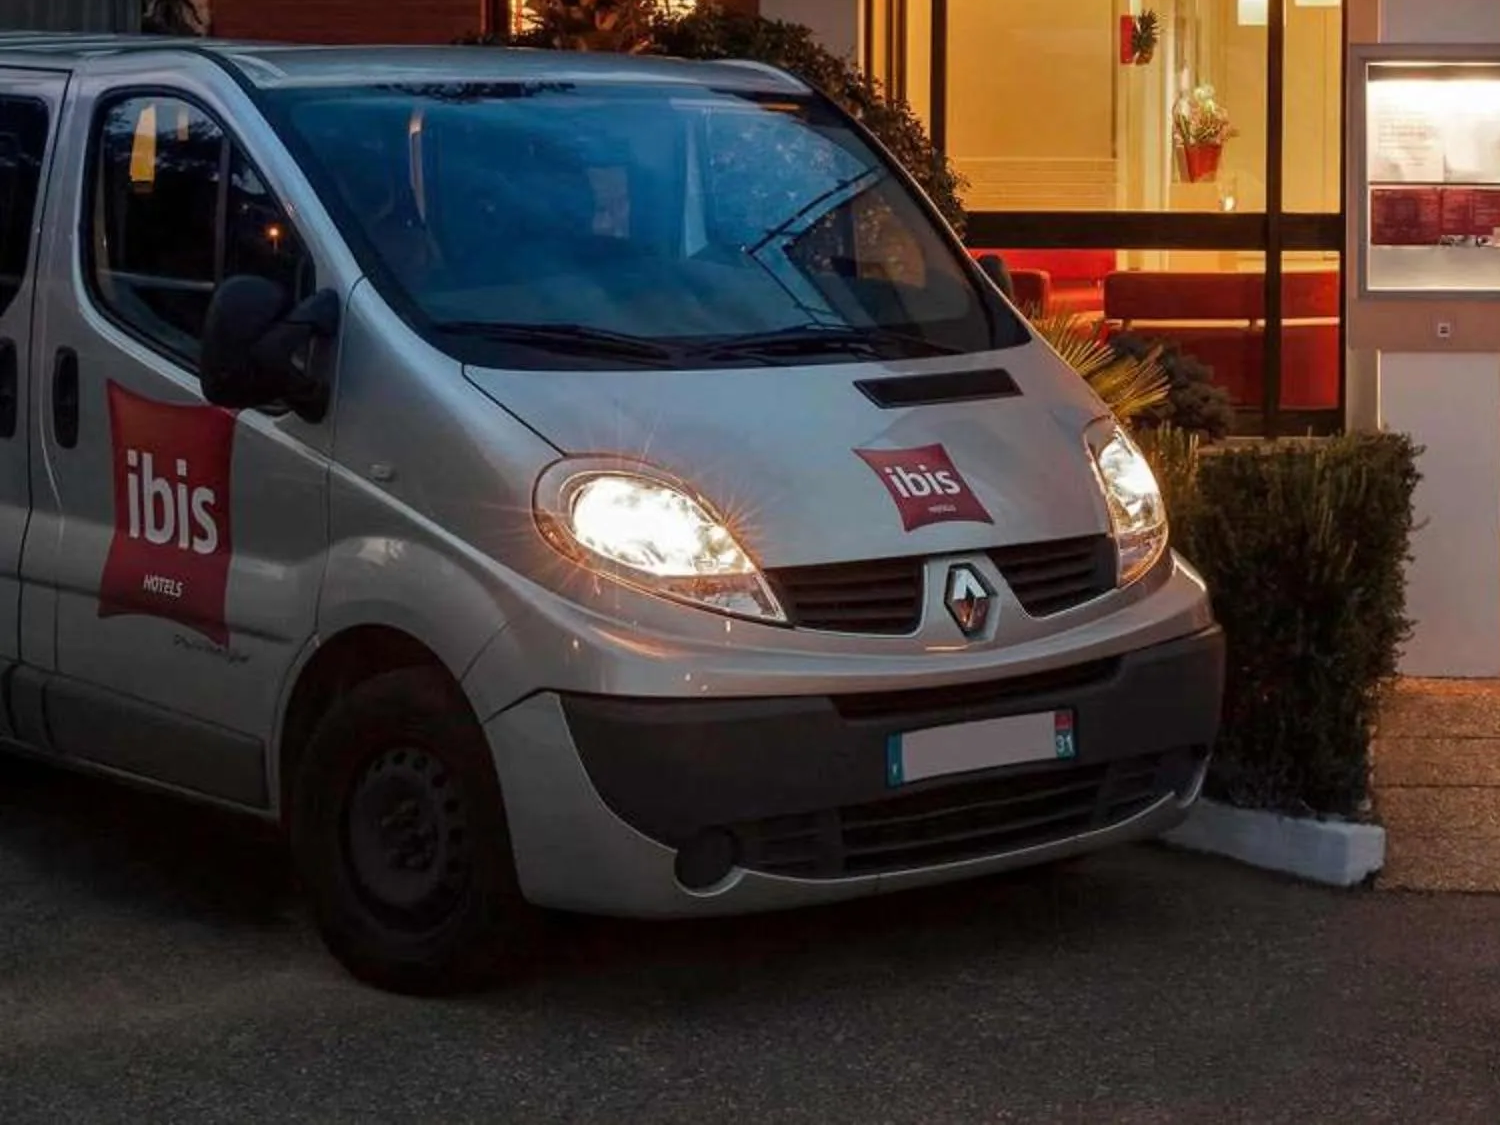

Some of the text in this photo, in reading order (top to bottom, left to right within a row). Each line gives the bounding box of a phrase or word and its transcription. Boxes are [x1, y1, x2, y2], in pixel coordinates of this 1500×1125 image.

[884, 464, 961, 498] ibis
[127, 449, 218, 555] ibis
[144, 575, 183, 598] HOTELS
[1057, 735, 1074, 754] 31
